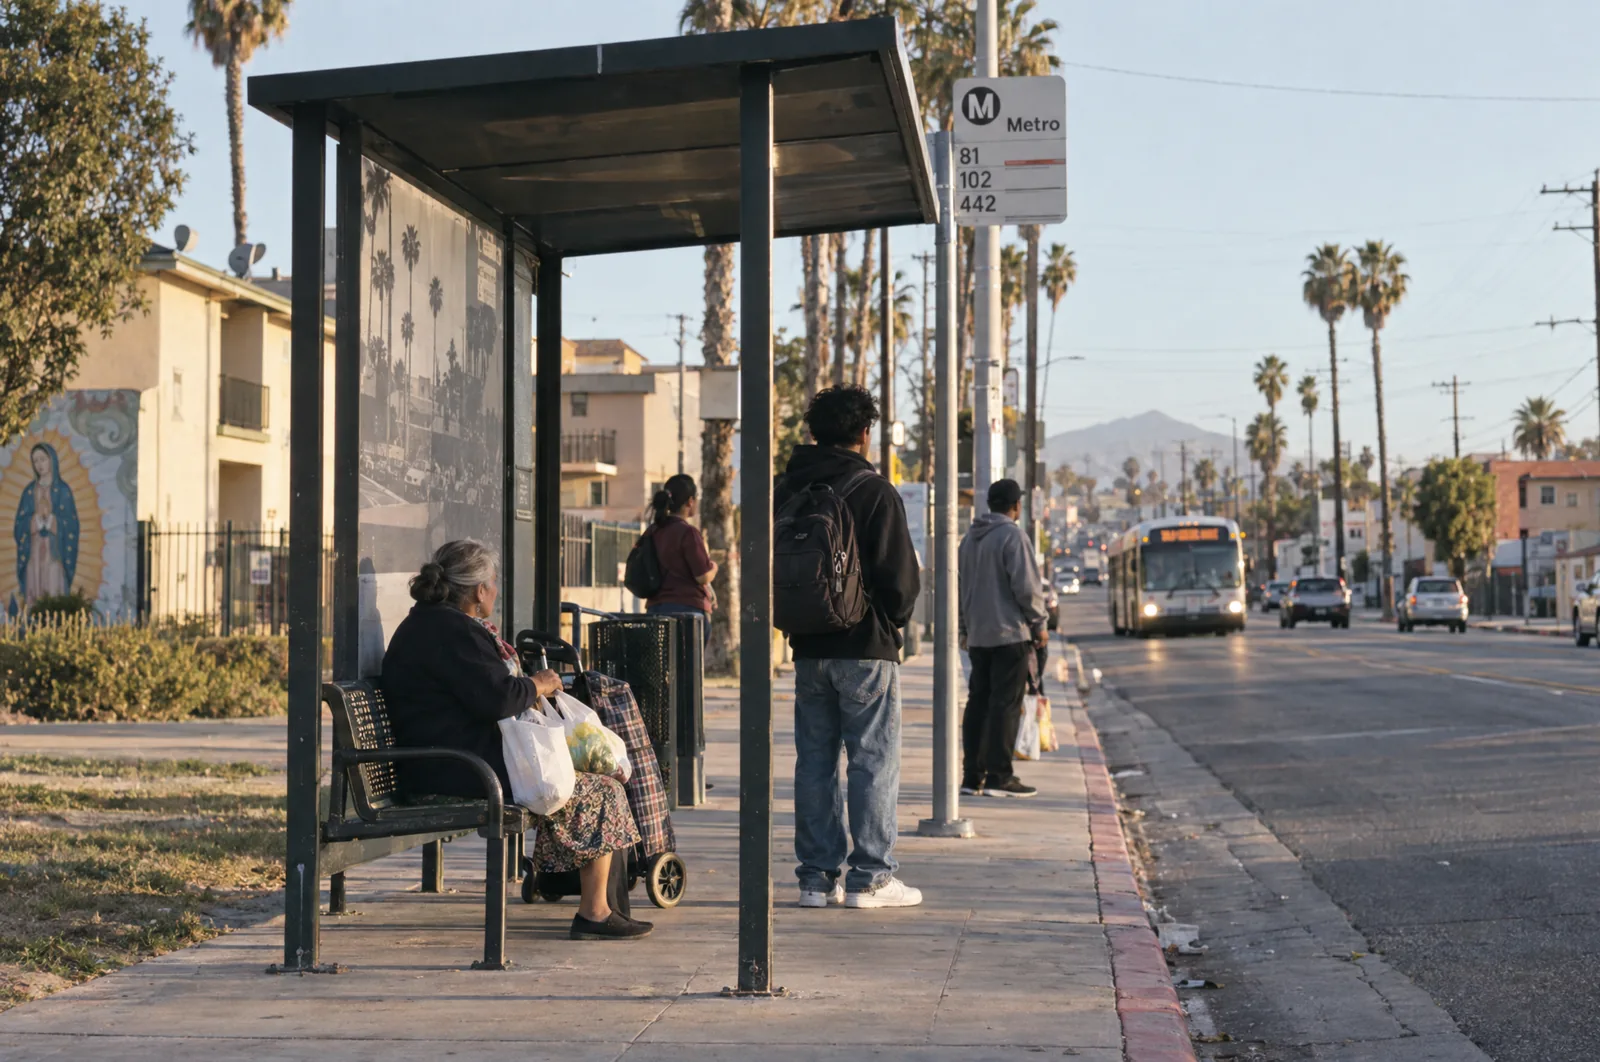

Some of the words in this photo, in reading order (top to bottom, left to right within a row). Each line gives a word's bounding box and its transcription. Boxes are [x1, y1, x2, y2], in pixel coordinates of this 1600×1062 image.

[967, 92, 994, 120] M
[1007, 117, 1060, 132] Metro
[960, 147, 979, 165] 81
[960, 171, 992, 189] 102
[960, 195, 997, 213] 442
